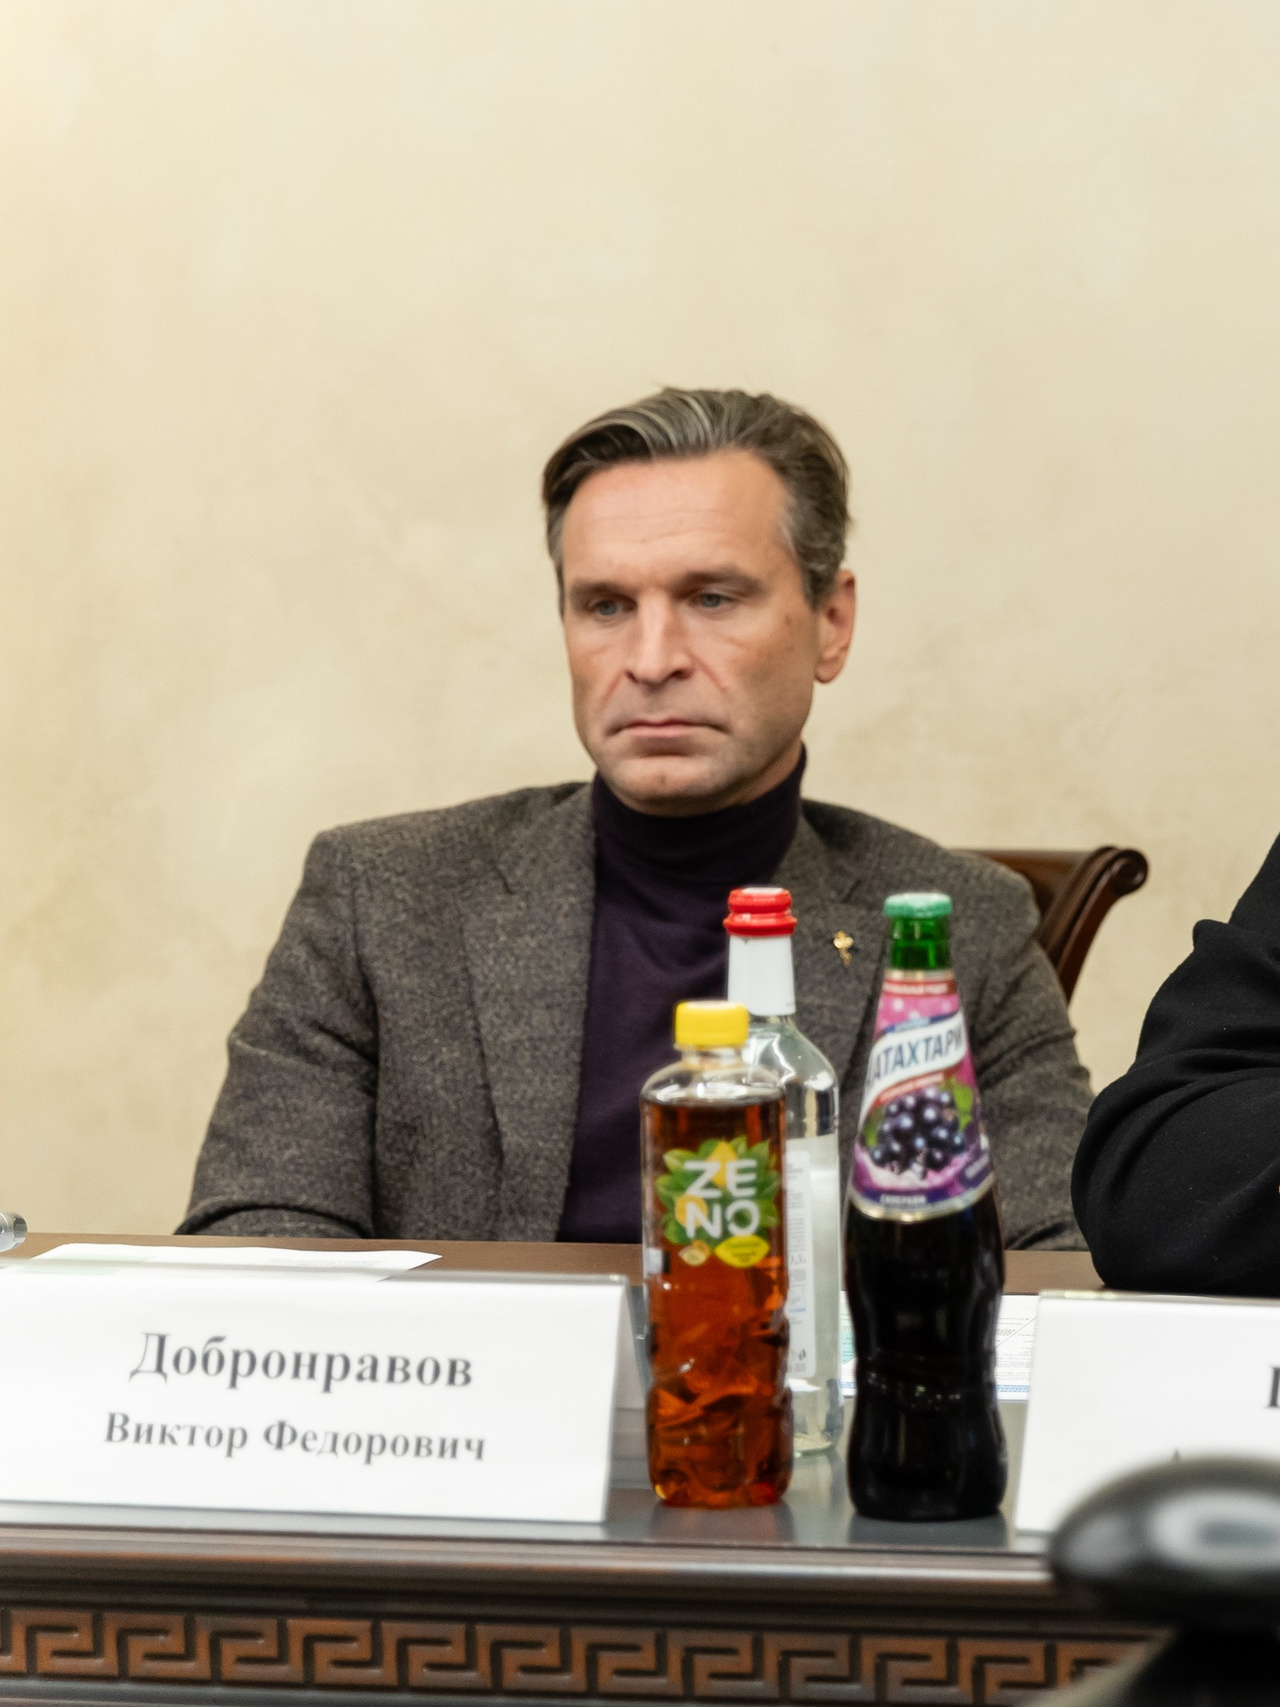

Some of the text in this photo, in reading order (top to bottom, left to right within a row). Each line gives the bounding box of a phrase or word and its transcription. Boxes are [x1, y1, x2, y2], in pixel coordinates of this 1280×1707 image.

[684, 1160, 758, 1198] ZE
[684, 1200, 760, 1238] NO
[130, 1333, 472, 1393] Добронравов
[105, 1412, 485, 1464] Виктор Федорович
